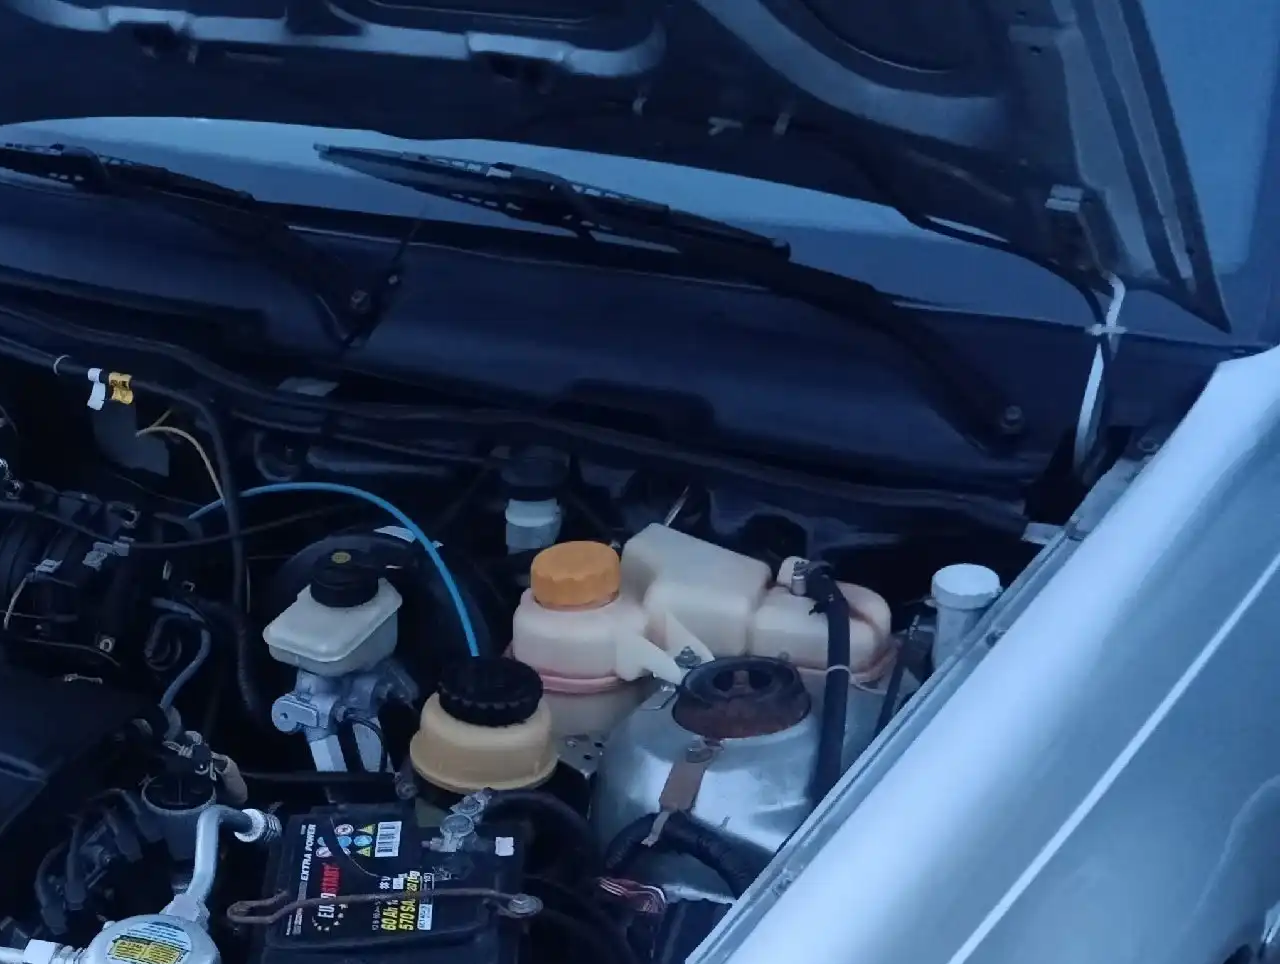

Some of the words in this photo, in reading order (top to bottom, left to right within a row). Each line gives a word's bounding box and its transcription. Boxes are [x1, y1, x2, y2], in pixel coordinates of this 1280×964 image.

[305, 824, 316, 851] POWER
[301, 854, 312, 881] EXTRA
[399, 913, 415, 930] 570
